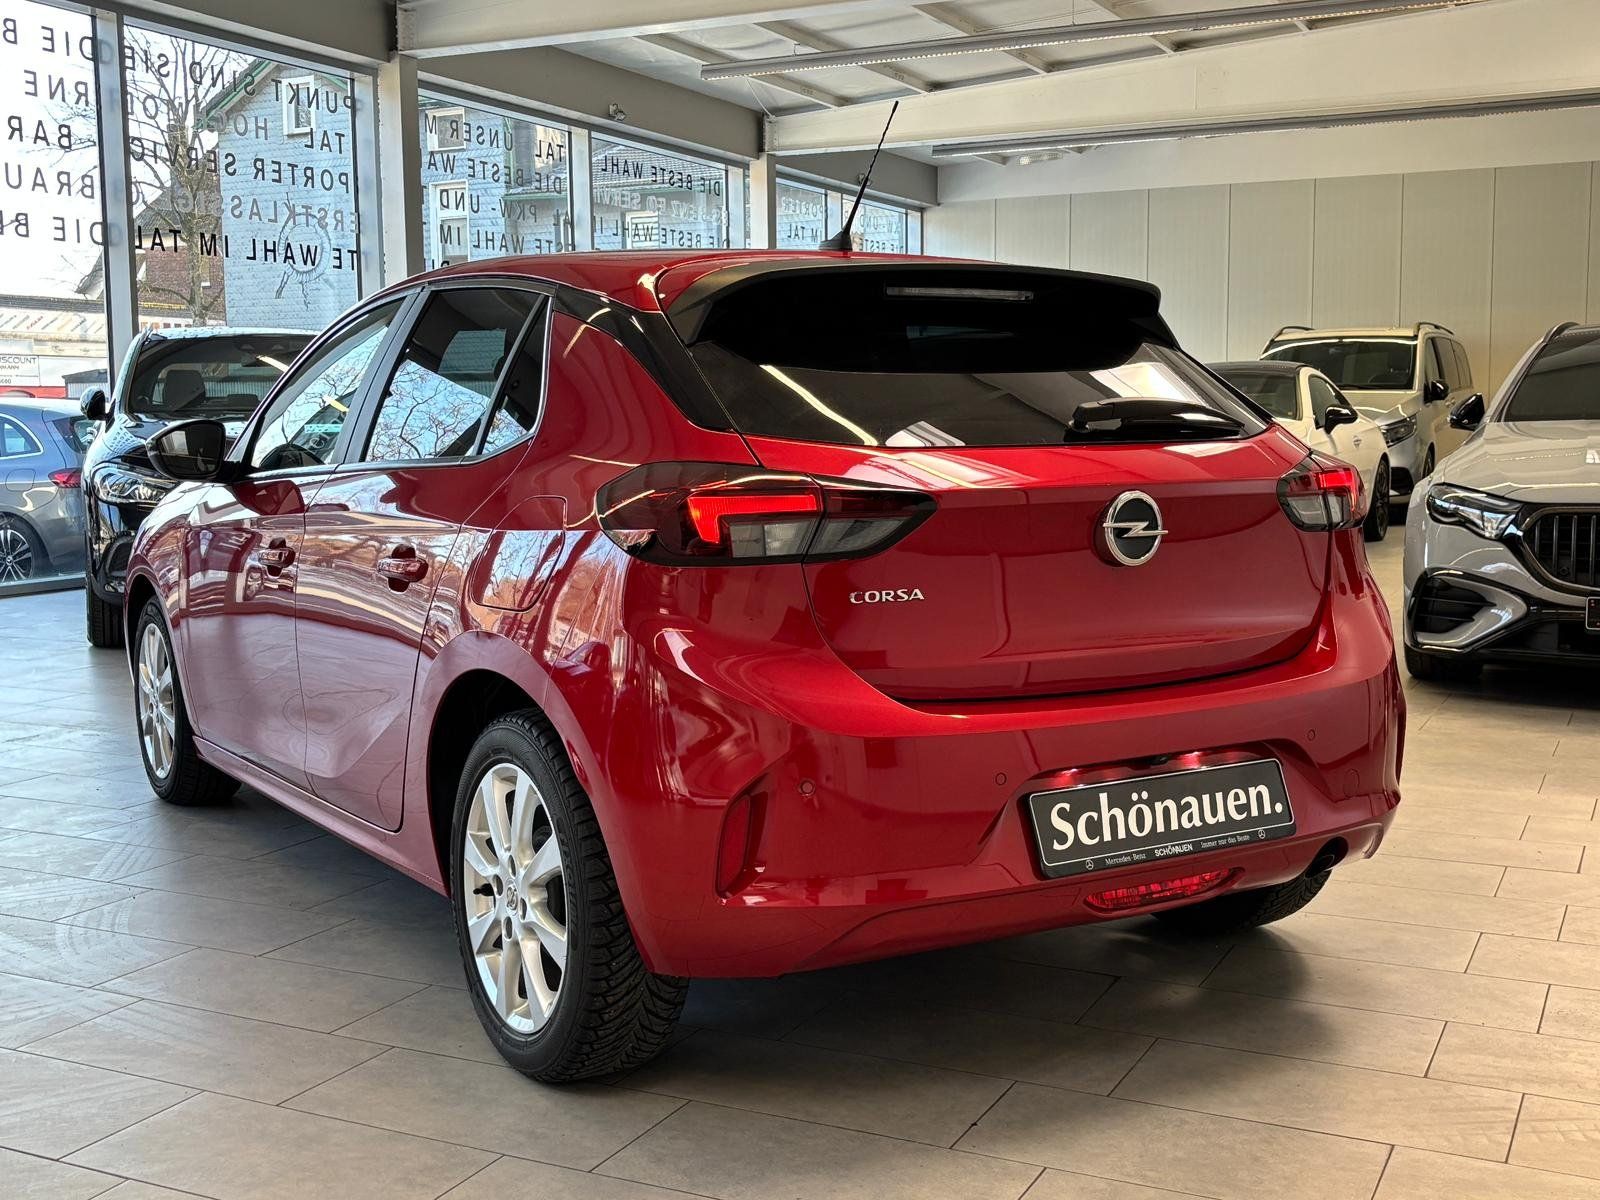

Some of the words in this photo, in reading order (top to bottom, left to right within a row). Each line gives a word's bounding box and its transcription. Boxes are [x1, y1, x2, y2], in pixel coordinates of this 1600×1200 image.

[849, 589, 925, 604] CORSA
[1050, 783, 1283, 851] Schönauen.
[1154, 843, 1194, 858] SCHÖNAUEN
